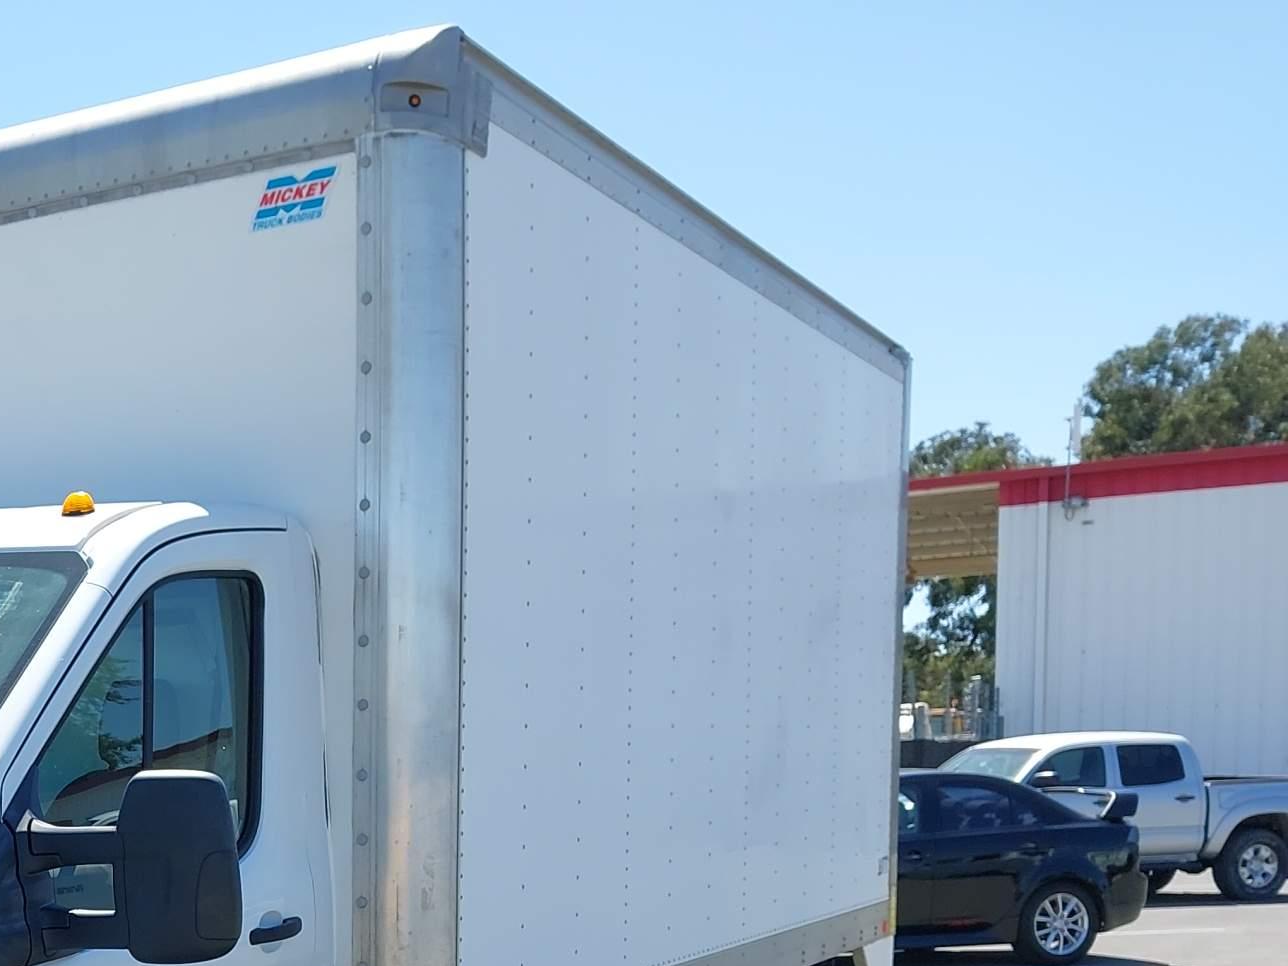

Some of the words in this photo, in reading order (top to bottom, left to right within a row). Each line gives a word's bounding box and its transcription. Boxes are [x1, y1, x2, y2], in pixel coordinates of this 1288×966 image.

[259, 179, 331, 207] MICKEY
[252, 216, 284, 232] TRUCK
[286, 209, 323, 225] BODIES
